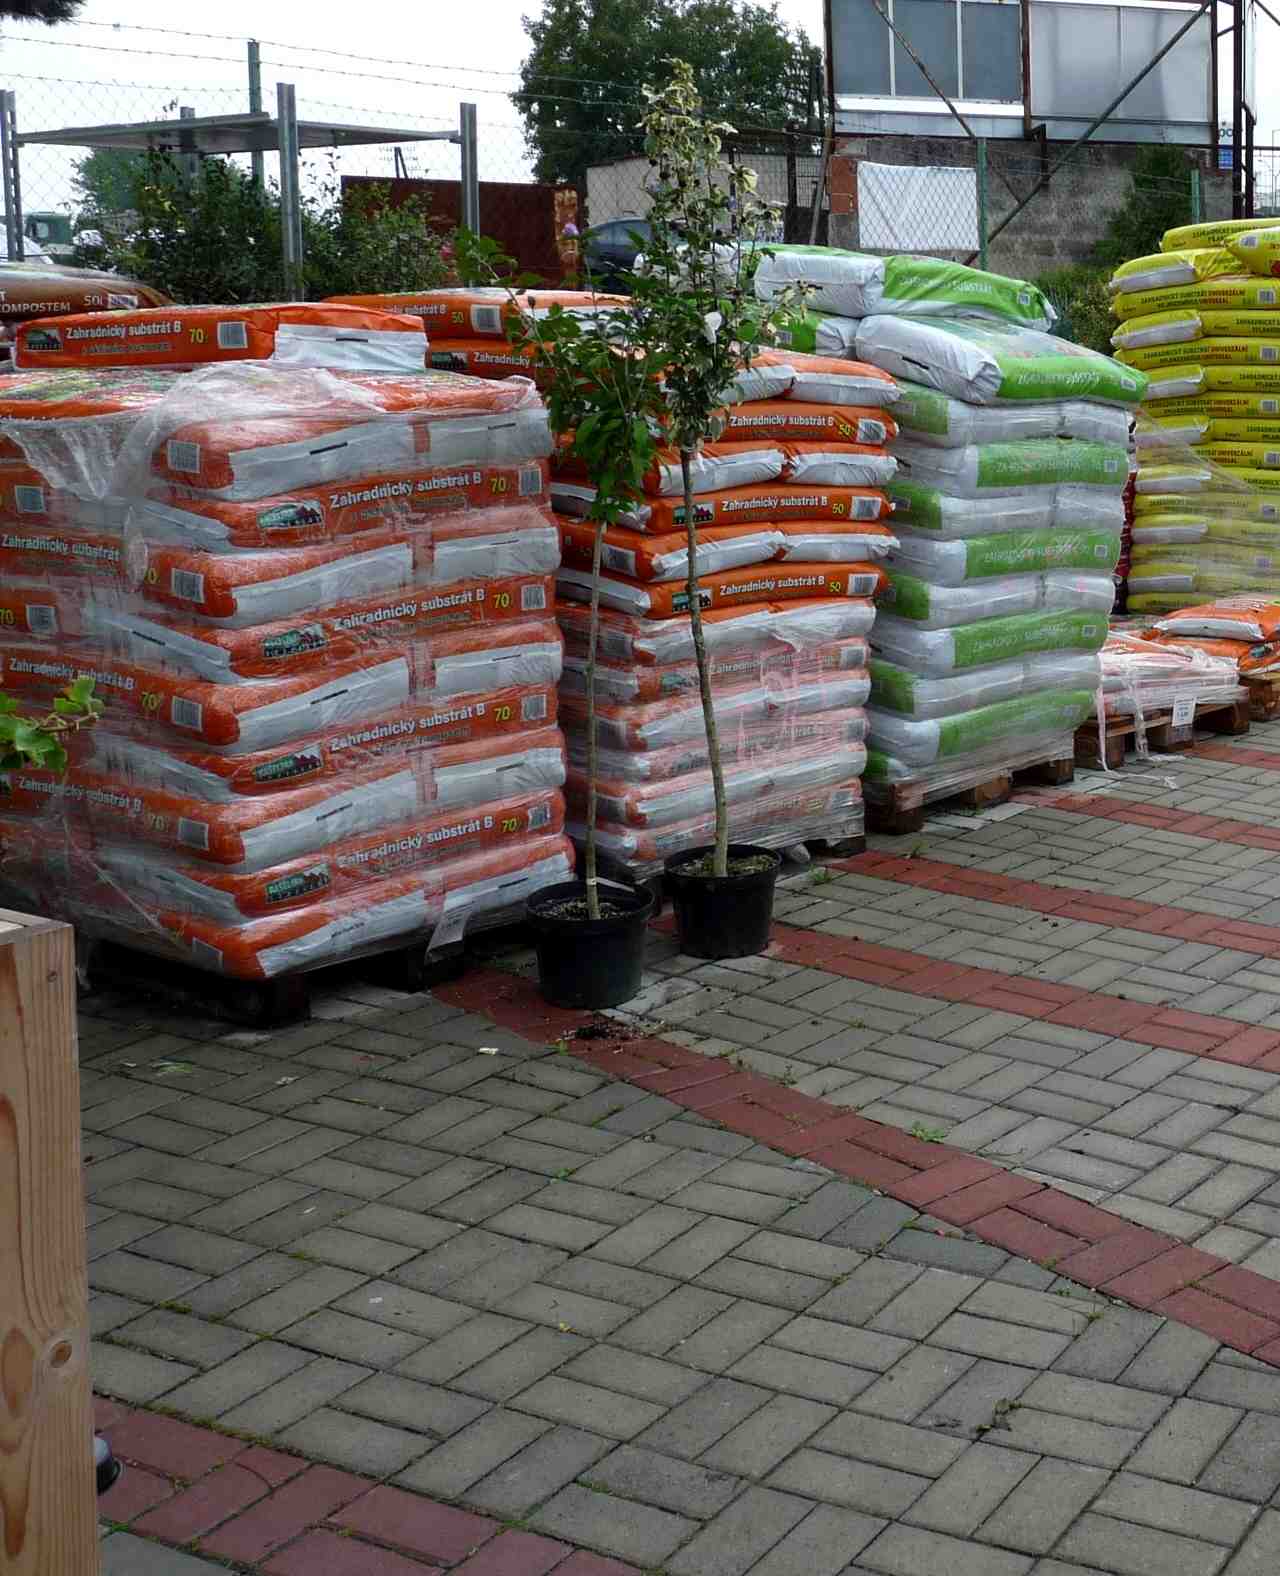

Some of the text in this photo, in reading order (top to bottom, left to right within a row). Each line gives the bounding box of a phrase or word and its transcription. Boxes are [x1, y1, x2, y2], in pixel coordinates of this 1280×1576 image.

[65, 320, 182, 340] Zahradnický substrát B
[730, 415, 786, 427] Zahradnický
[789, 415, 826, 426] substrát
[330, 481, 414, 509] Zahradnický
[417, 473, 470, 491] substrát
[472, 471, 481, 485] B
[722, 496, 827, 511] Zahradnický substrát B
[720, 576, 825, 595] Zahradnický substrát B
[333, 603, 417, 631] Zahradnický
[420, 592, 473, 611] substrát
[476, 588, 485, 601] B
[329, 719, 417, 752] Zahradnický
[419, 706, 473, 730] substrát
[475, 703, 487, 716] B
[427, 820, 481, 843] substrát
[484, 815, 494, 829] B
